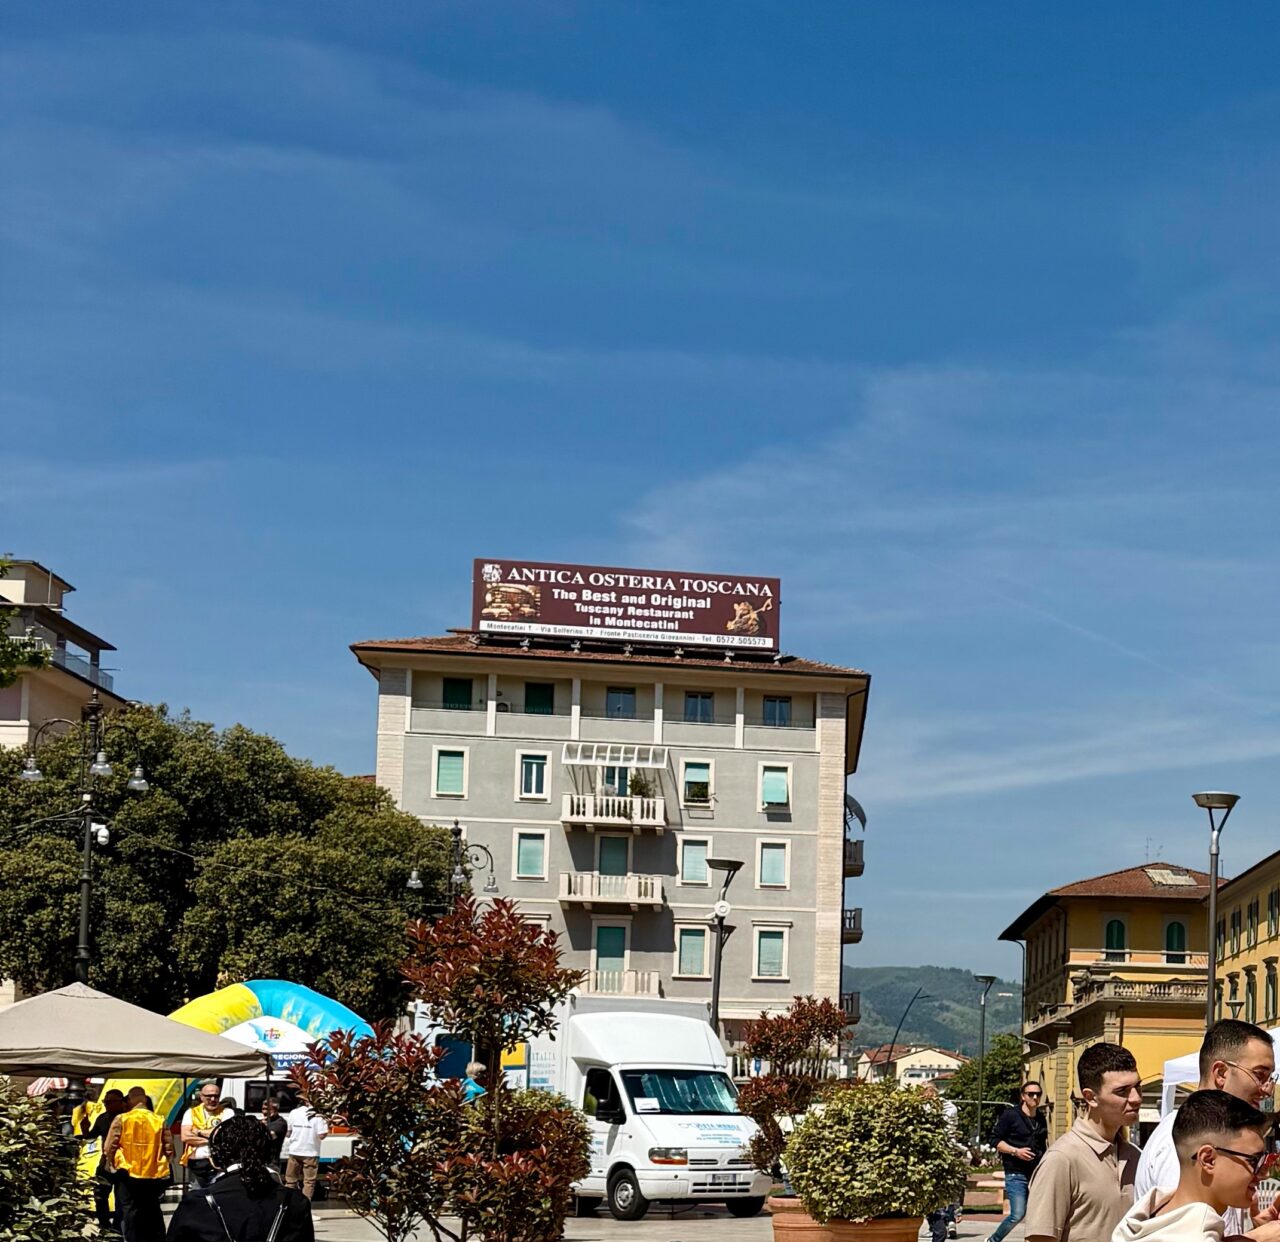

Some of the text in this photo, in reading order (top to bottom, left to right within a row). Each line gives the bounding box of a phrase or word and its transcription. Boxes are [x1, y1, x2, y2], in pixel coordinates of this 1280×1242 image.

[507, 567, 773, 597] ANTICA OSTERIA TOSCANA
[552, 588, 711, 609] The Best and Original
[574, 602, 694, 620] Tuscany Restaurant
[604, 616, 679, 630] Montecatini
